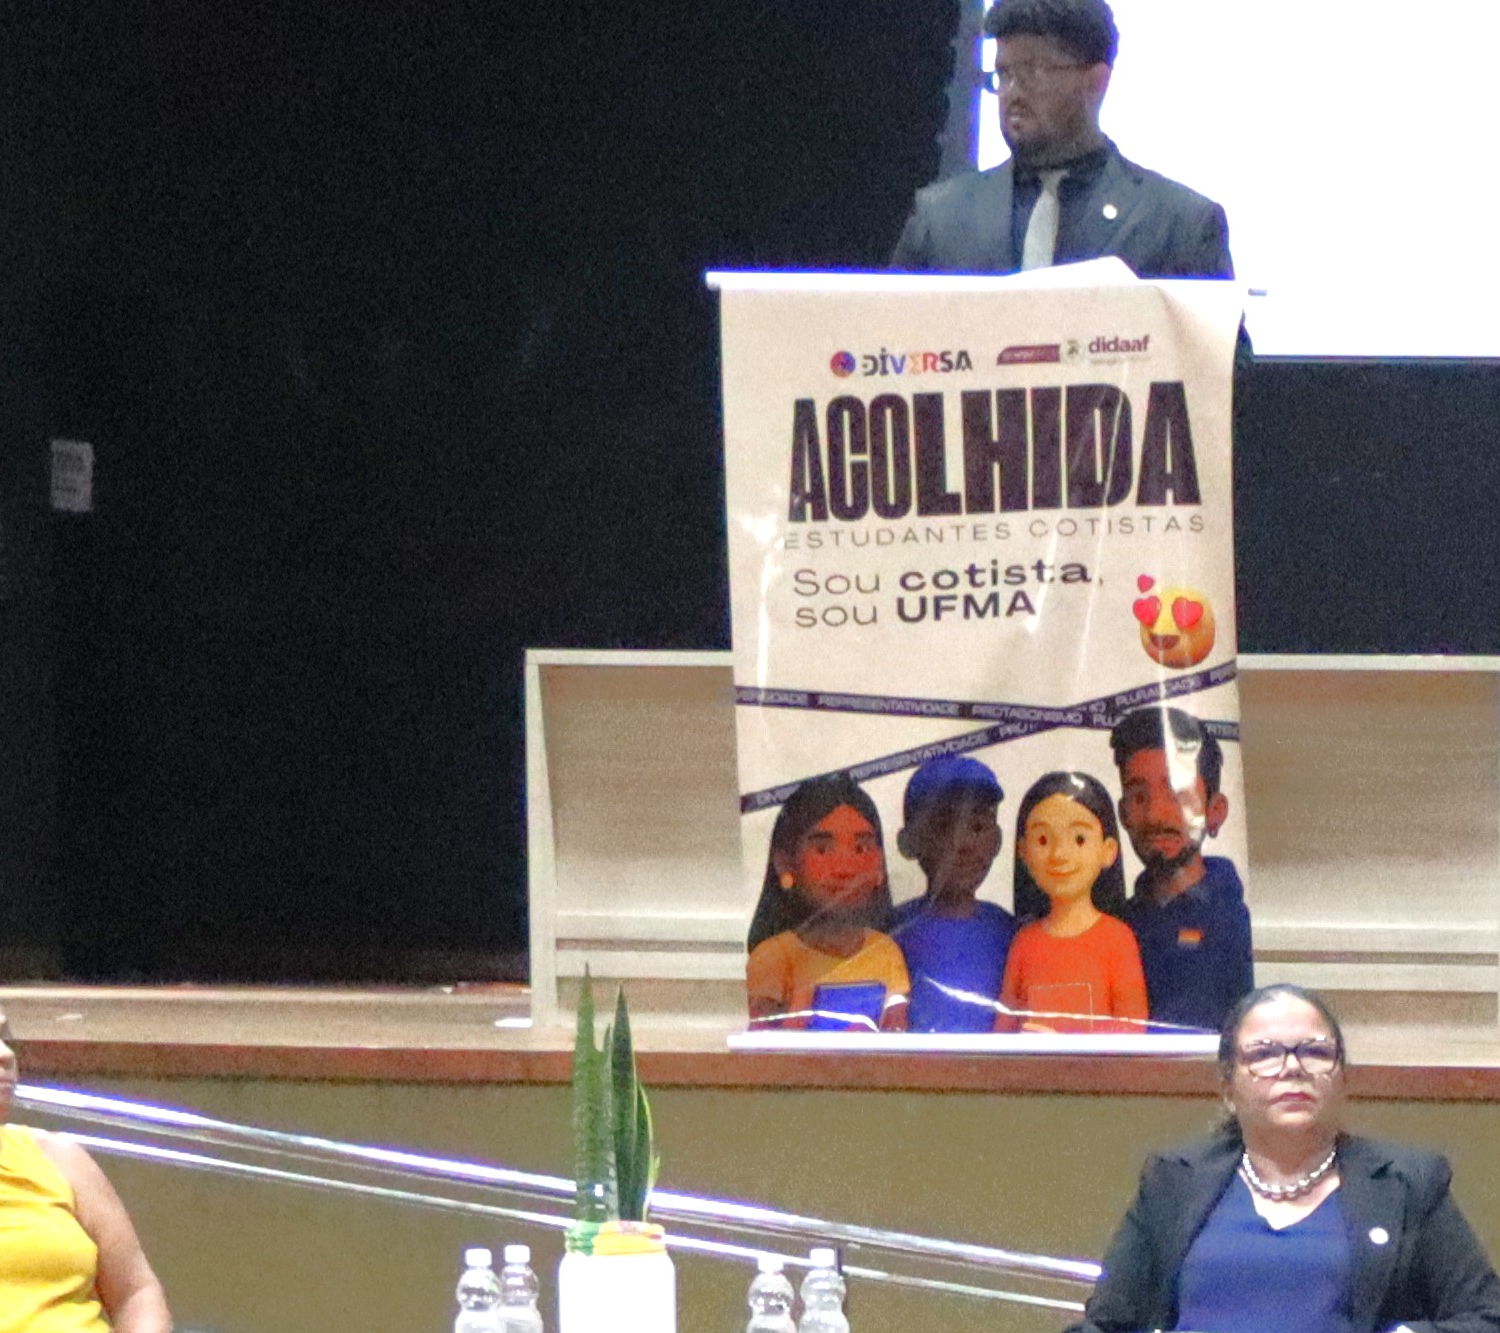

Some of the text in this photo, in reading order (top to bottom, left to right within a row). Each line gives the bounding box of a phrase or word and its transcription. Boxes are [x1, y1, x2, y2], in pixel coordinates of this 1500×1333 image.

[1088, 334, 1151, 354] didaaf
[787, 380, 1203, 523] ACOLHIDA
[784, 514, 1205, 551] ESTUDANTES COTISTAS
[793, 568, 882, 597] Sou
[794, 590, 1037, 629] sou UFMA
